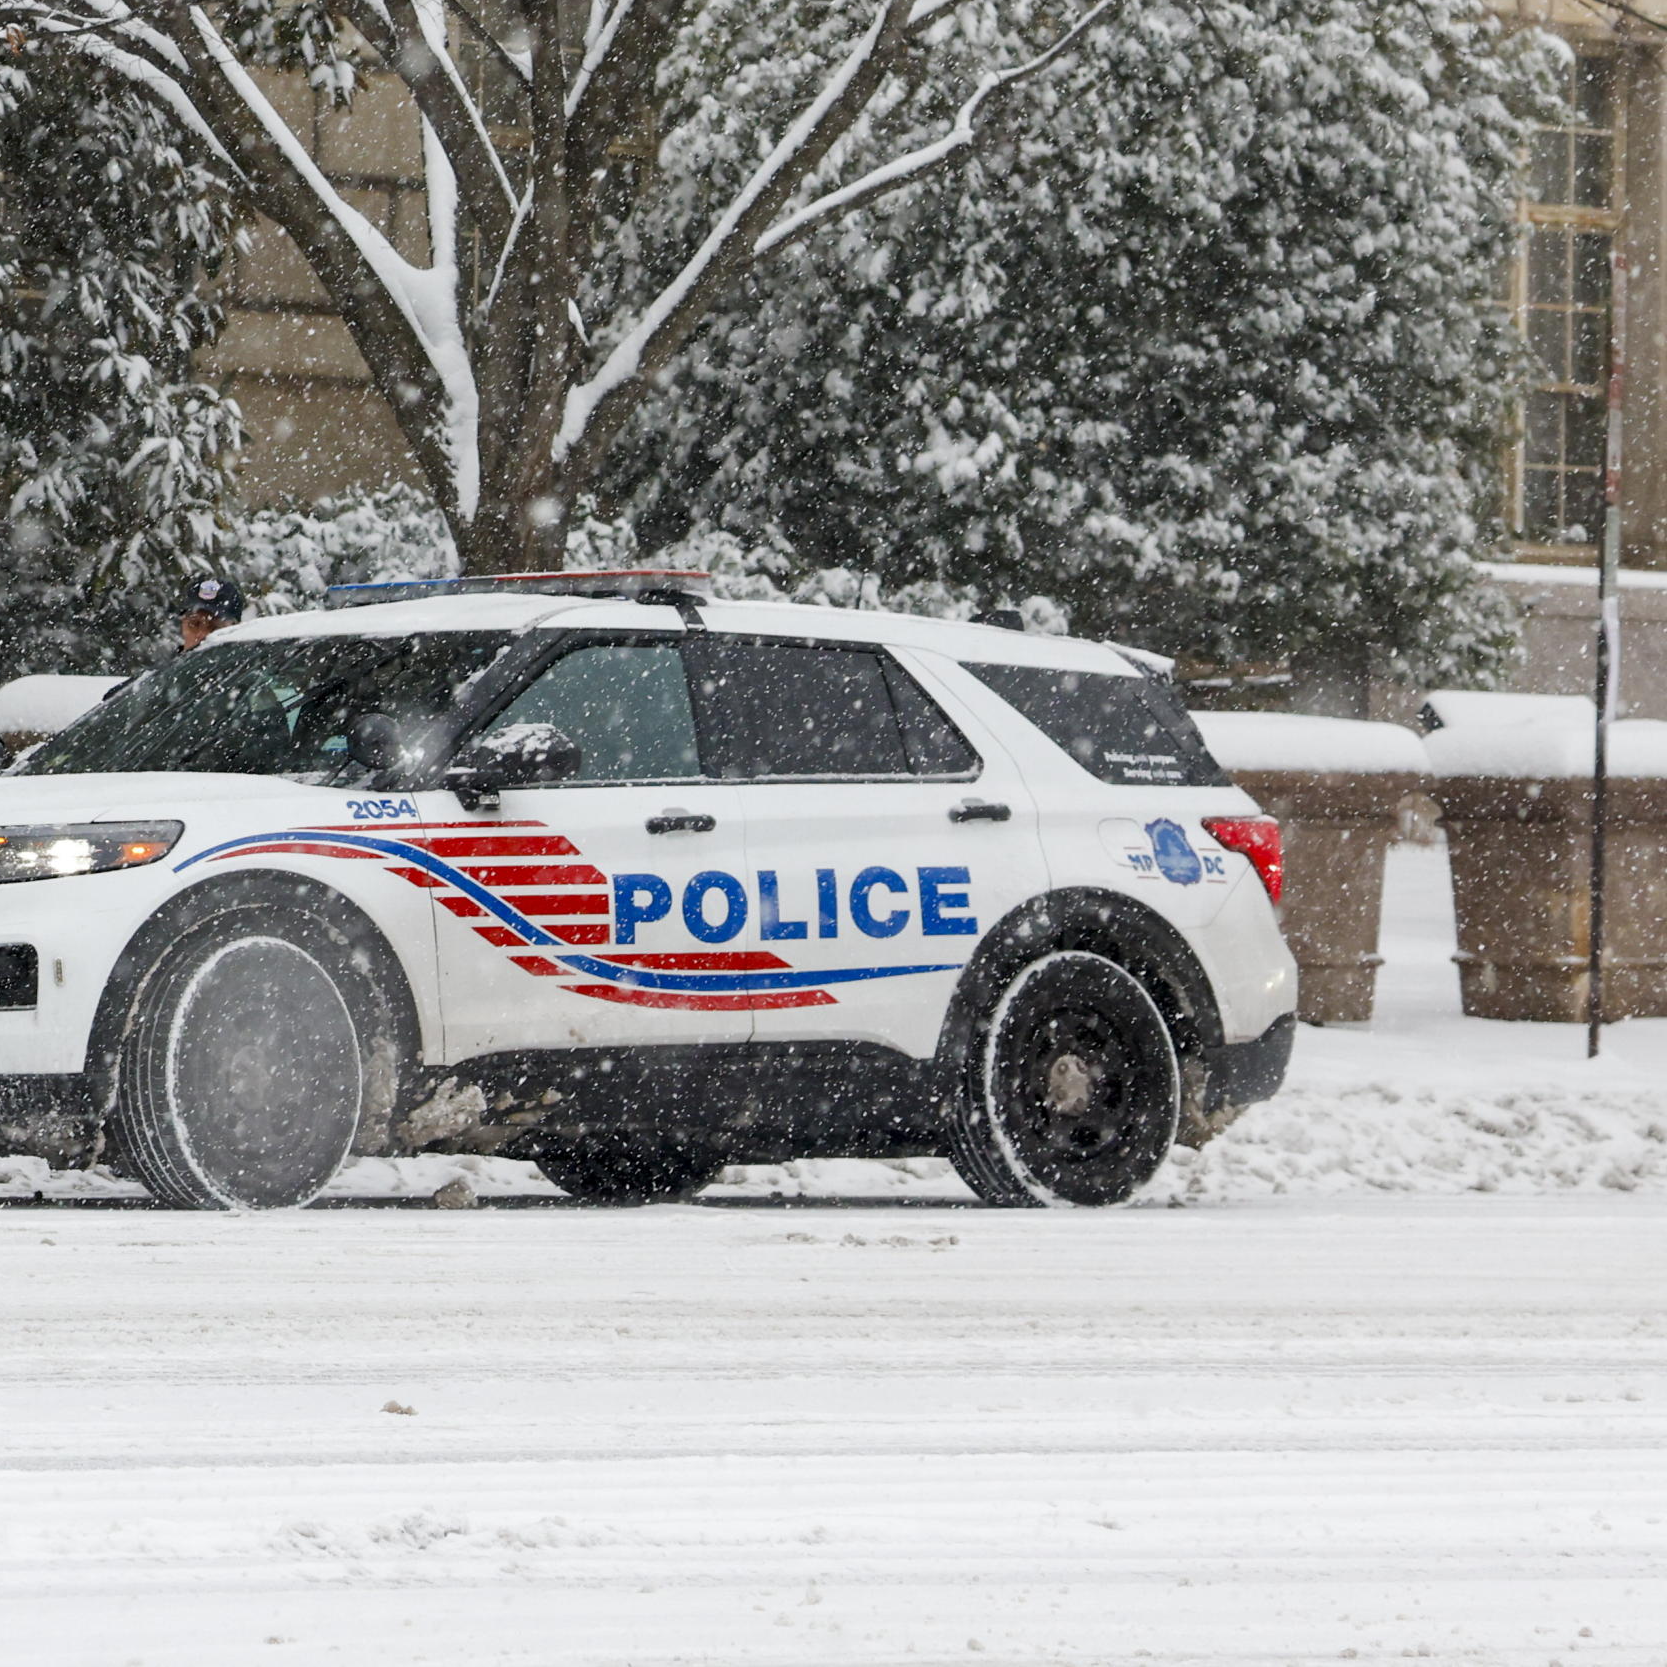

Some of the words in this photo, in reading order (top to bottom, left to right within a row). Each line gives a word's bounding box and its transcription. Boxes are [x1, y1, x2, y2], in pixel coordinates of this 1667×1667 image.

[346, 799, 416, 819] 2054
[1203, 856, 1225, 875] DC
[612, 866, 979, 945] POLICE
